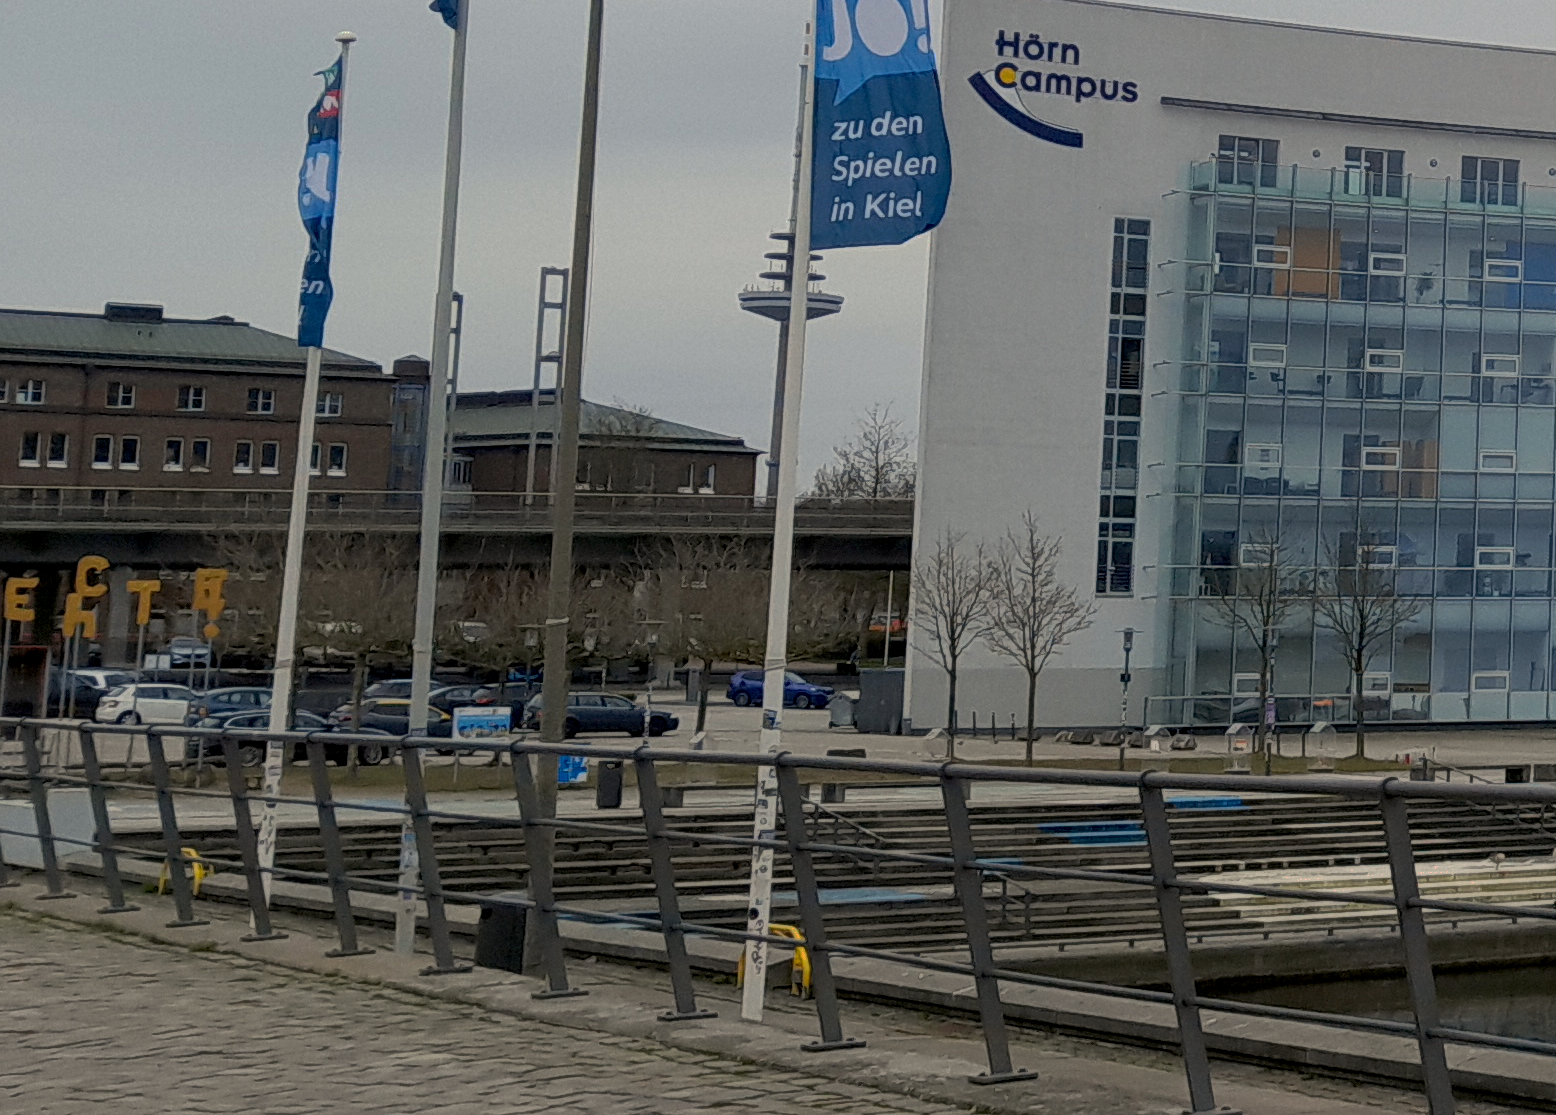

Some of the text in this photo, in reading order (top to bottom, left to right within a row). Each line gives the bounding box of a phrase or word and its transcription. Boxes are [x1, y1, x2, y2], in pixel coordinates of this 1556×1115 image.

[995, 29, 1080, 65] Hörn
[995, 62, 1139, 103] Campus
[831, 110, 923, 141] zu den
[831, 150, 937, 187] Spielen
[830, 190, 922, 222] in Kiel
